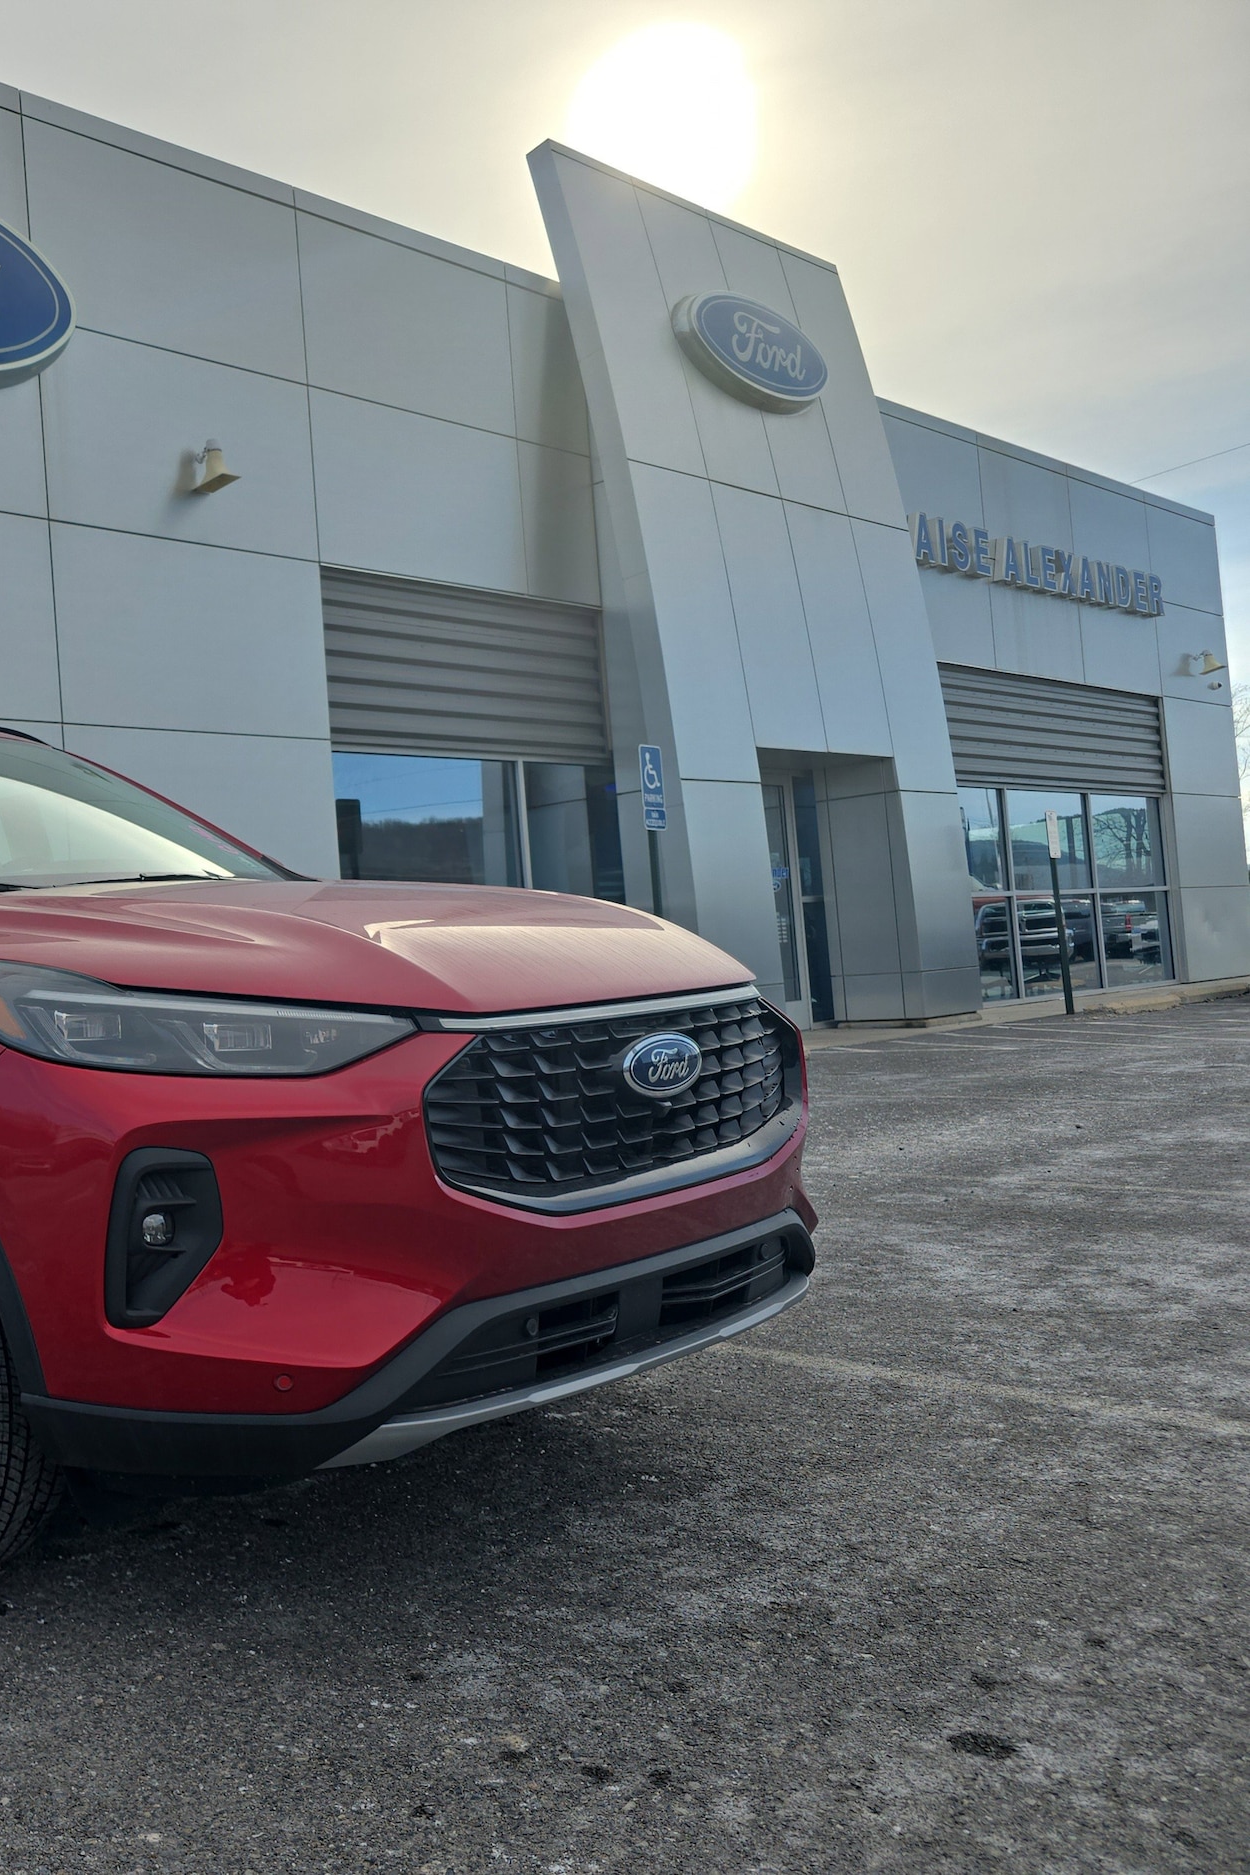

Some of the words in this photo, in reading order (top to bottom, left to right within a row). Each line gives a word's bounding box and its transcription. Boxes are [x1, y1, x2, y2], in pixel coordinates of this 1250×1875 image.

[731, 311, 807, 381] Ford
[912, 511, 992, 577] AISE
[1003, 535, 1165, 617] ALEXANDER
[648, 1047, 690, 1083] Ford
